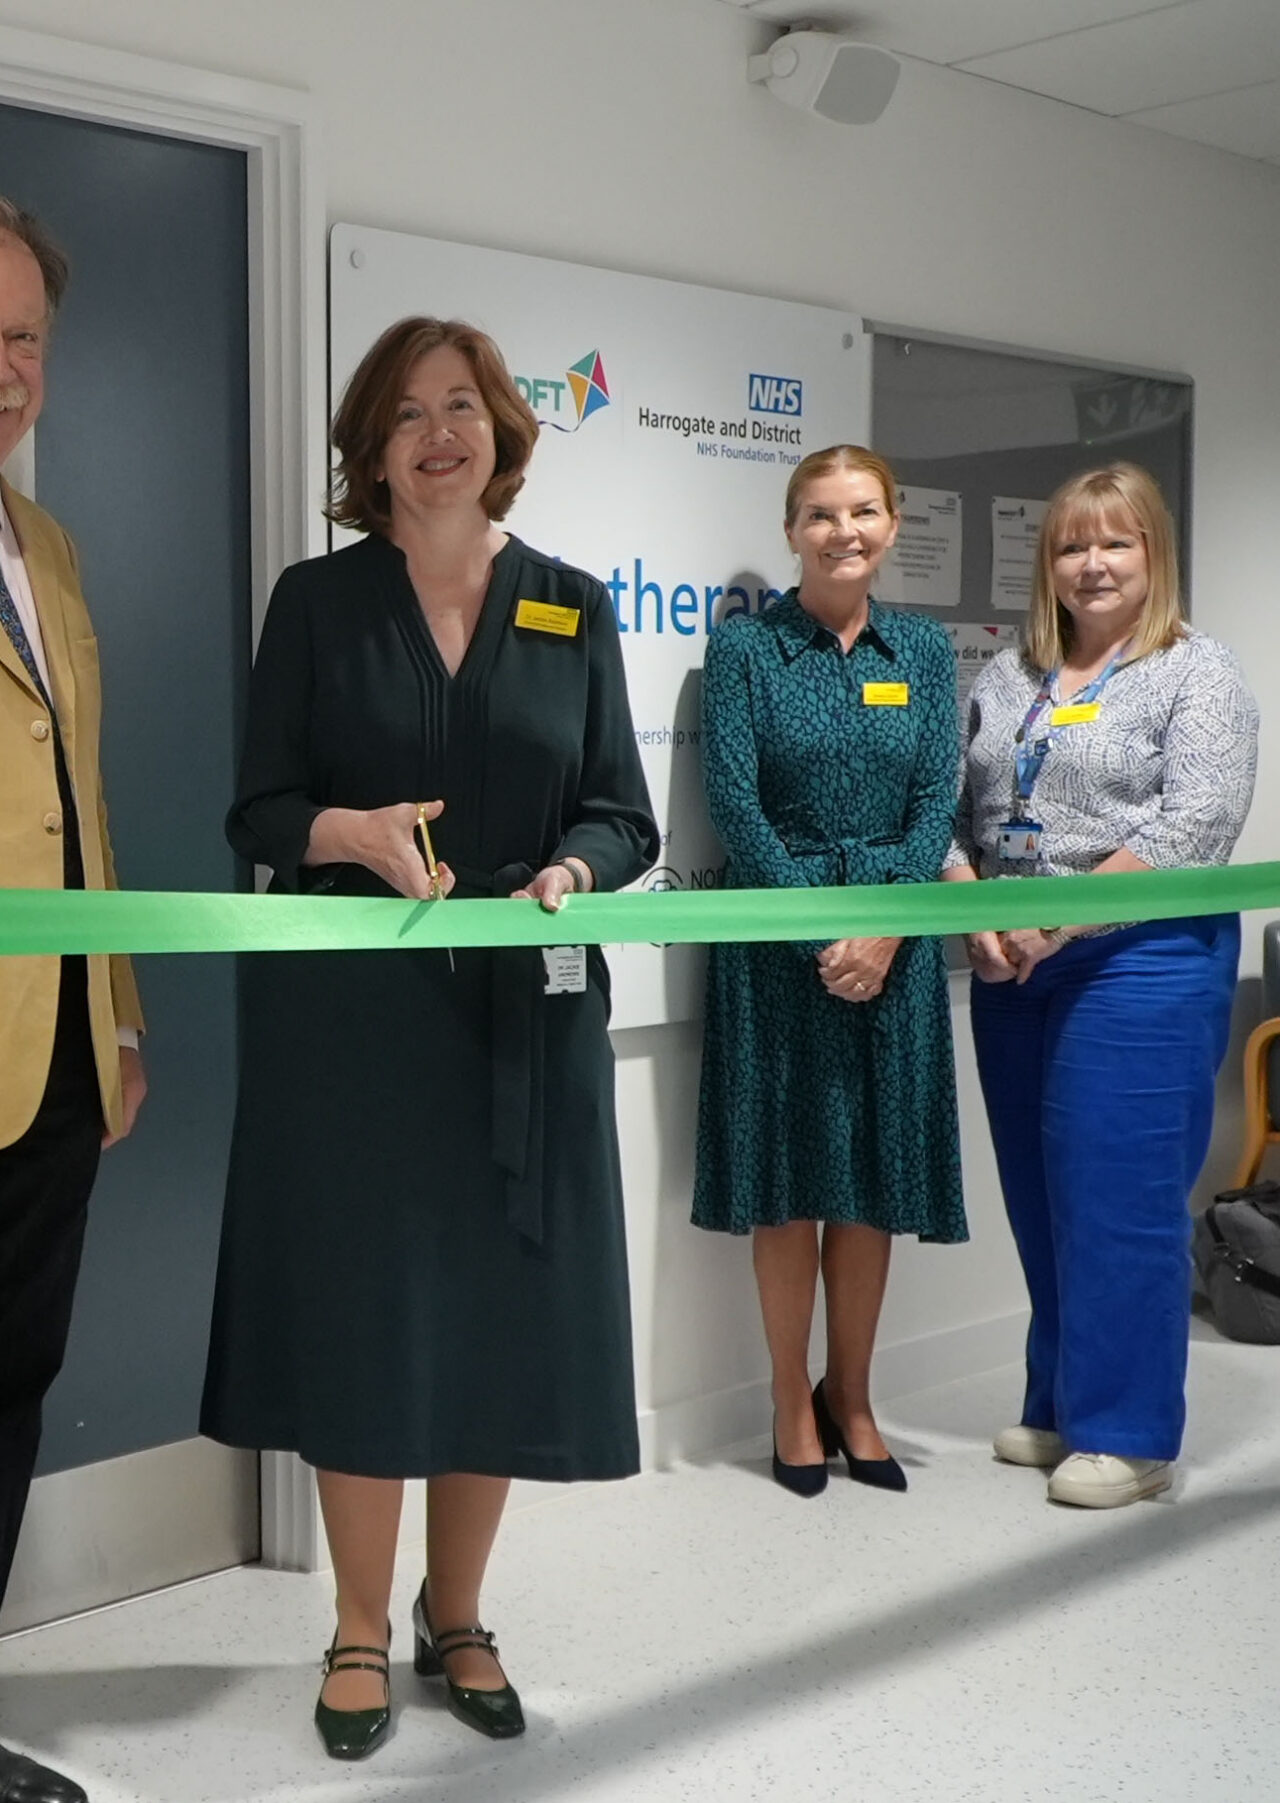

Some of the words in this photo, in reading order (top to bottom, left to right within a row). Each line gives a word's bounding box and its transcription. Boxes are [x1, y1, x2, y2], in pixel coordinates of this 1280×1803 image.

[749, 376, 801, 414] NHS
[639, 407, 716, 437] Harrogate
[719, 418, 747, 438] and
[752, 421, 801, 445] District
[697, 442, 719, 457] NHS
[721, 444, 776, 463] Foundation
[778, 450, 801, 465] Trust
